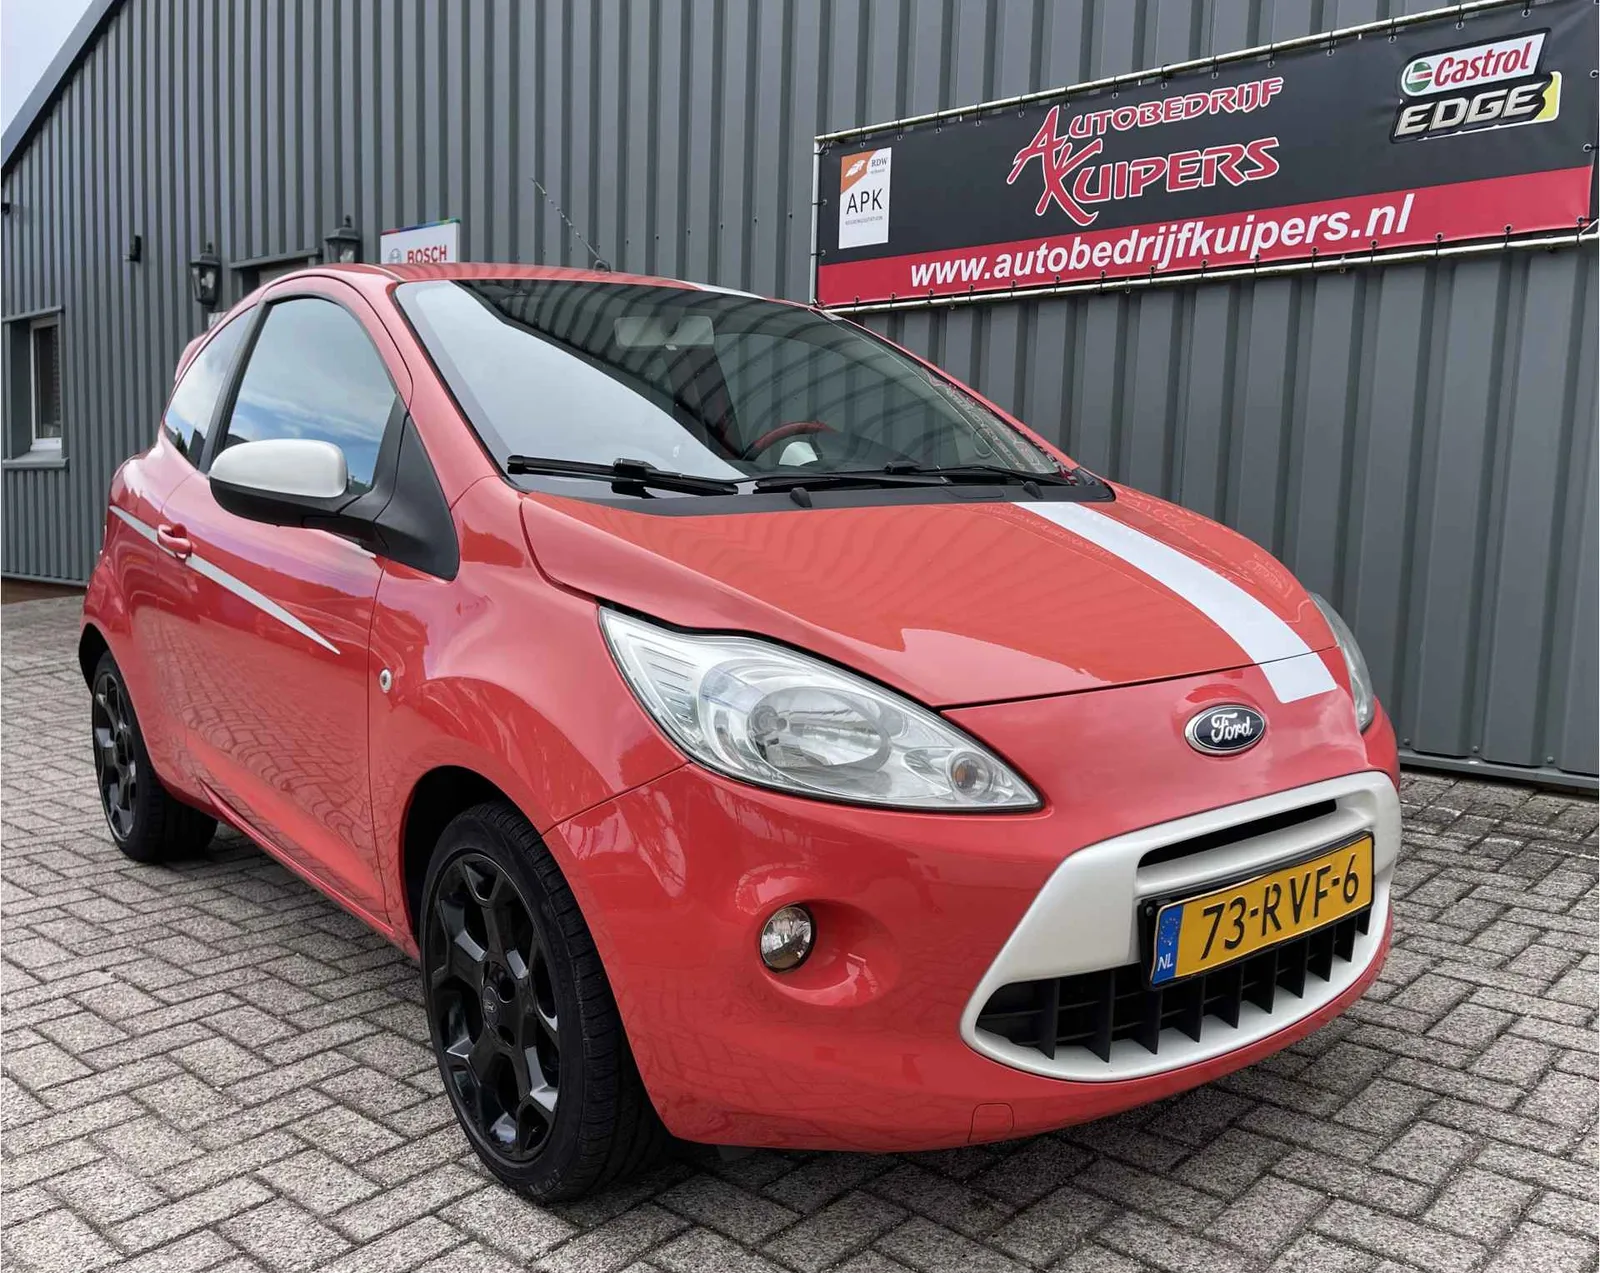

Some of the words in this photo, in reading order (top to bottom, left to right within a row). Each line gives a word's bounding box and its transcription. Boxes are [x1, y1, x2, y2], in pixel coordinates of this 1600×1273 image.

[1434, 41, 1533, 87] Castrol
[1006, 77, 1284, 184] AUTOBEDRIJF
[1394, 82, 1548, 137] EDGE
[871, 157, 888, 168] RDW
[1035, 137, 1280, 226] KUIPERS
[846, 188, 883, 215] APK
[407, 244, 447, 264] BOSCH
[910, 193, 1415, 287] www.autobedrijfkuipers.nl
[1210, 712, 1253, 743] Ford
[1200, 853, 1360, 961] 73-RVF-6
[1156, 952, 1174, 972] NL
